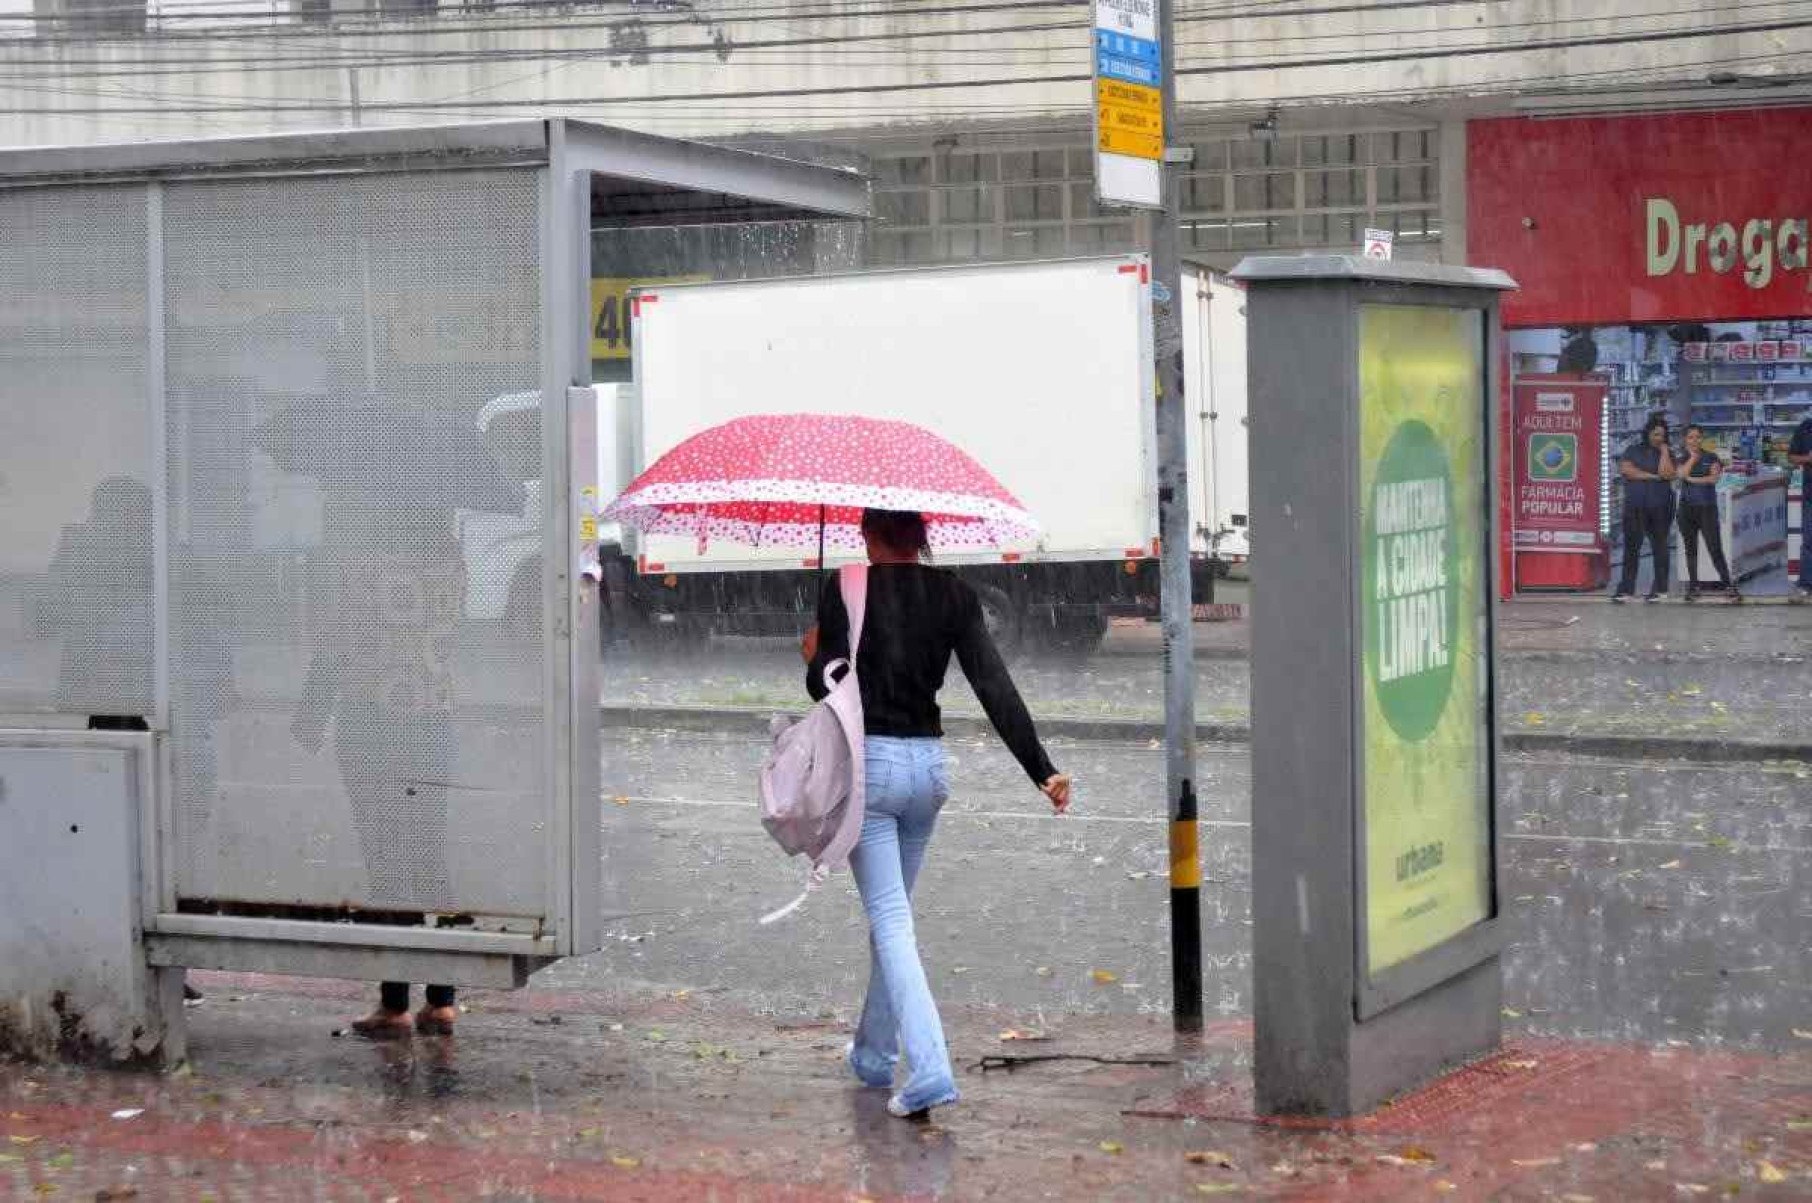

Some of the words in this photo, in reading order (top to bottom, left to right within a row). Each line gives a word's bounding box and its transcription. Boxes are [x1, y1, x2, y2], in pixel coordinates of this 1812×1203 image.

[1647, 198, 1808, 289] Droga
[1521, 501, 1583, 514] POPULAR
[1377, 537, 1388, 600] A
[1392, 529, 1447, 596] CIDADE
[1379, 590, 1447, 682] LIMPA!
